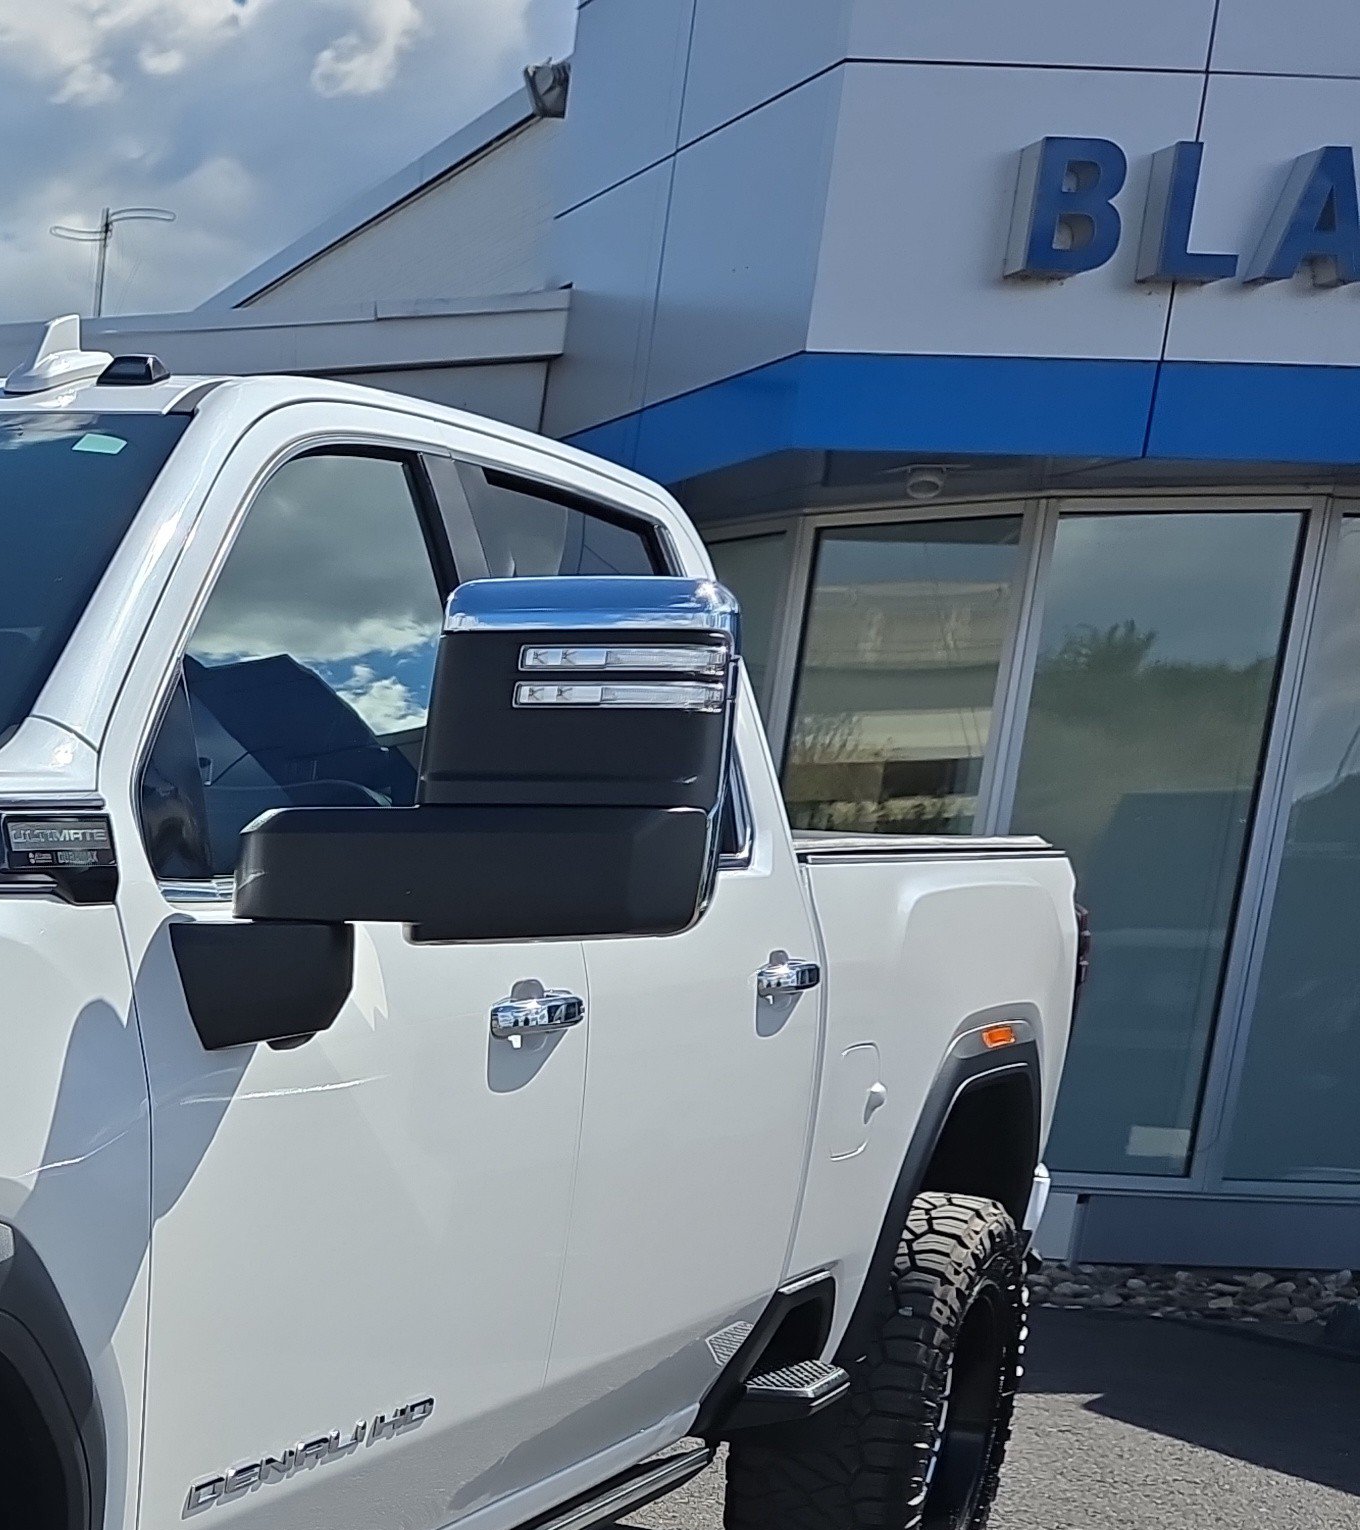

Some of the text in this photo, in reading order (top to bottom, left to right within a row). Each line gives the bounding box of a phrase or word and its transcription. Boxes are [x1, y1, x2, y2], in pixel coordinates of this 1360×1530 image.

[1004, 135, 1360, 288] BLA
[11, 828, 107, 843] ULTIMATE
[180, 1395, 435, 1520] DENALI HD
